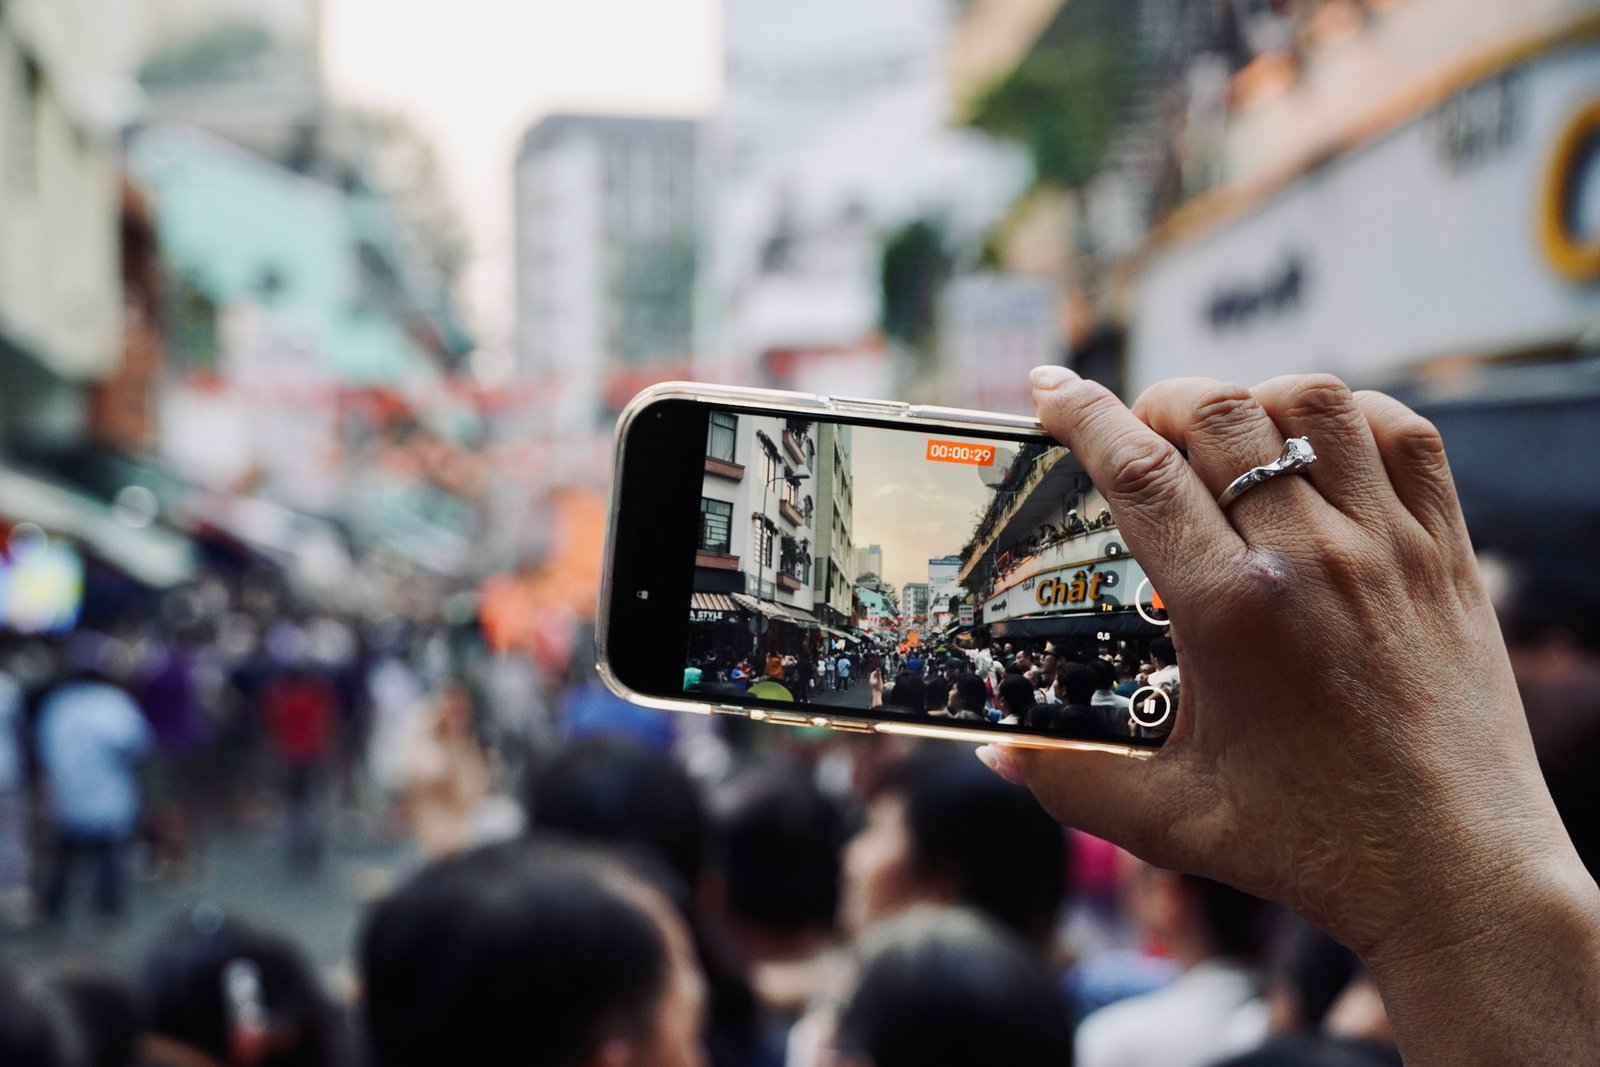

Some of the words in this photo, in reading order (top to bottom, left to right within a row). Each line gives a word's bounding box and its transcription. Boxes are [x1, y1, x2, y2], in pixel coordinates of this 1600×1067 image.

[930, 444, 991, 462] 00:00:29
[1110, 546, 1117, 555] 3
[1107, 575, 1114, 584] 2
[1036, 564, 1104, 606] Chất
[1102, 603, 1113, 612] 1x
[698, 611, 722, 619] STYLE
[1097, 631, 1111, 641] 0,5
